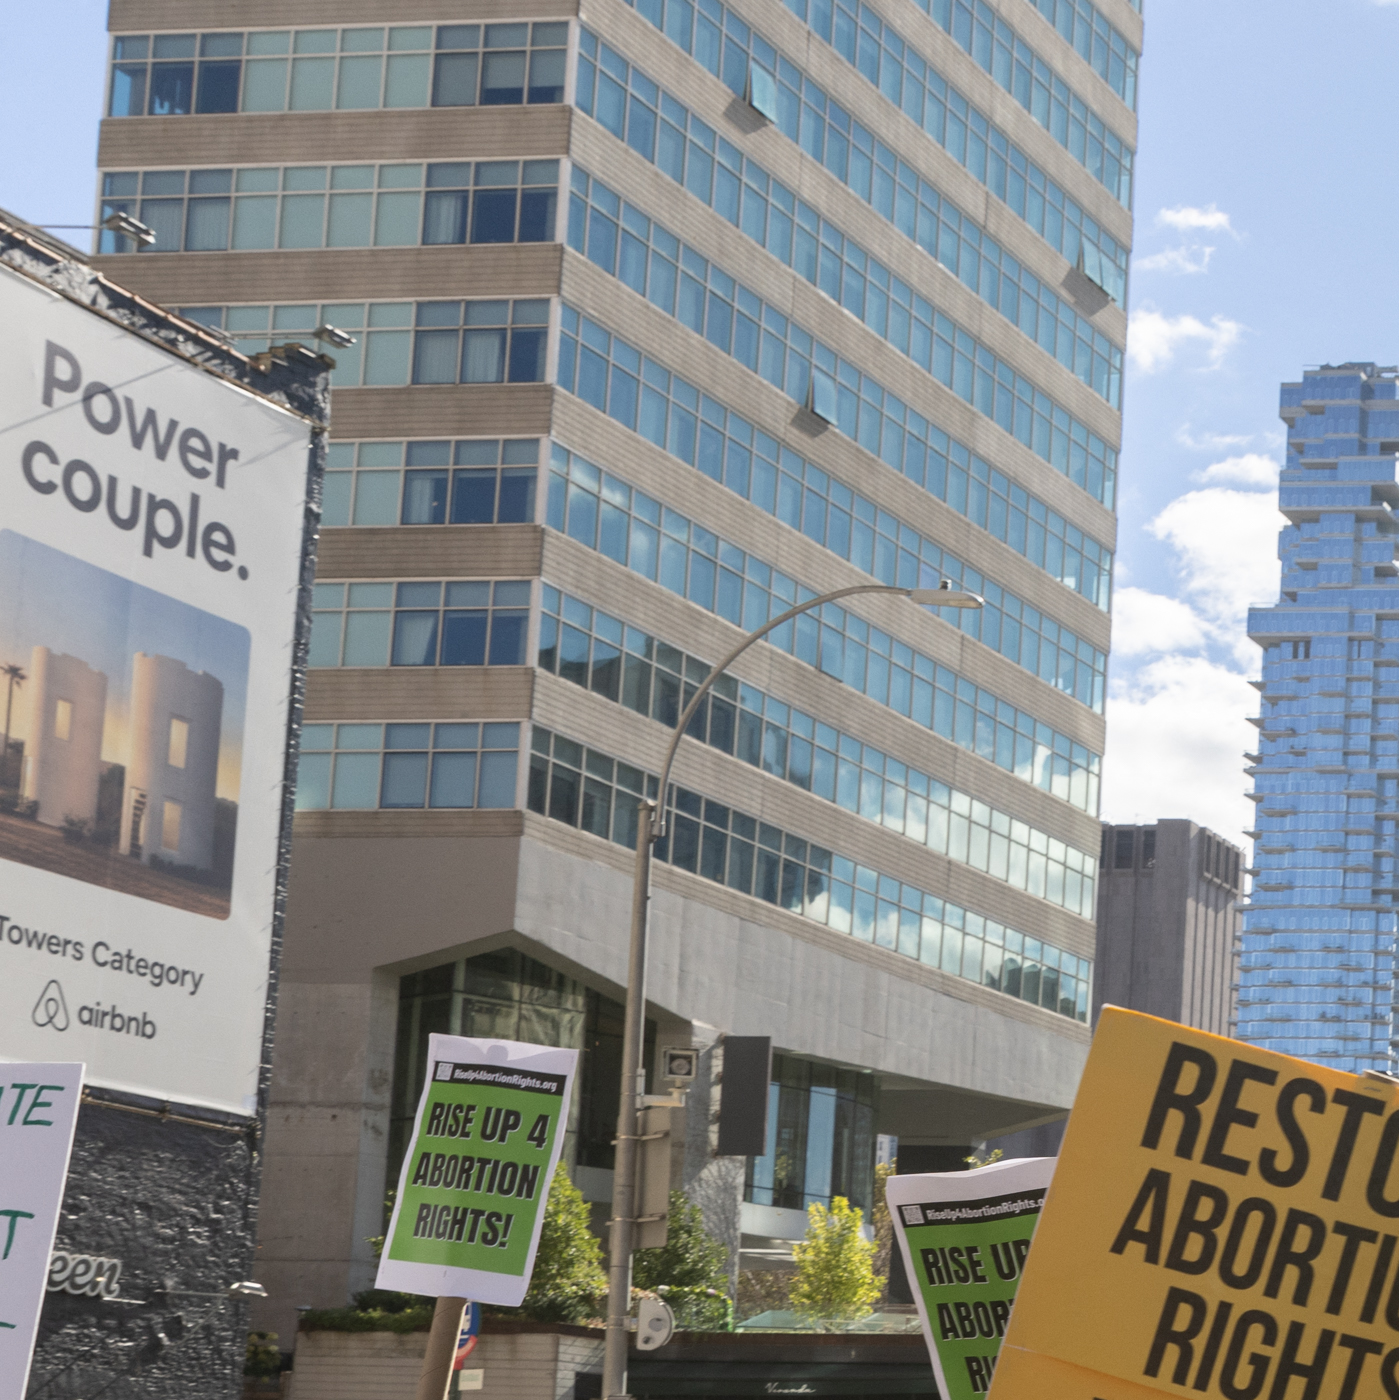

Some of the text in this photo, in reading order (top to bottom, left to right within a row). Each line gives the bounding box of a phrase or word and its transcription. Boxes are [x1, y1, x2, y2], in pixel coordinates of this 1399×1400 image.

[41, 339, 239, 490] Power
[21, 440, 249, 581] couple.
[91, 940, 205, 995] Category
[78, 1001, 157, 1040] airbnb
[453, 1067, 558, 1093] RiseUp4AbortionRights.org
[426, 1101, 551, 1150] RISE UP 4
[412, 1152, 541, 1200] ABORTION
[413, 1203, 517, 1248] RIGHTS!
[926, 1198, 1044, 1222] RiseUp4AbortionRights.o
[920, 1245, 989, 1287] RISE
[937, 1298, 1015, 1341] ABOR
